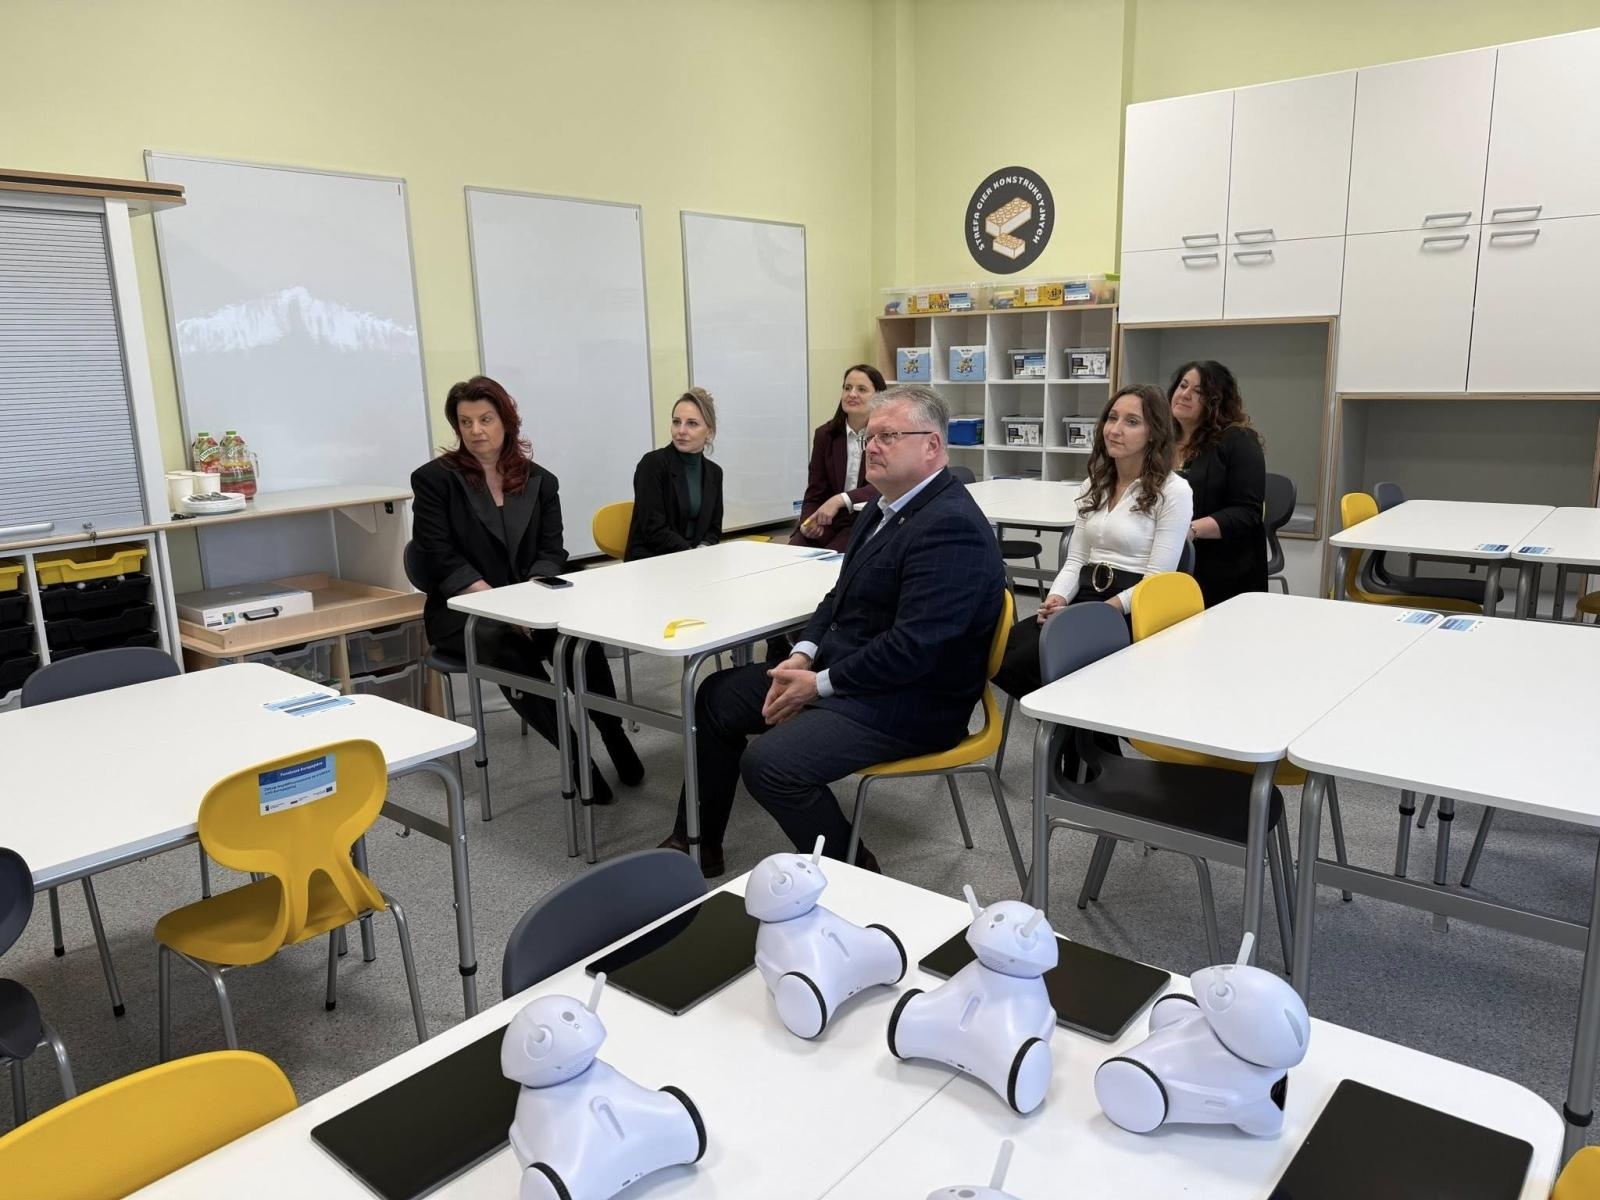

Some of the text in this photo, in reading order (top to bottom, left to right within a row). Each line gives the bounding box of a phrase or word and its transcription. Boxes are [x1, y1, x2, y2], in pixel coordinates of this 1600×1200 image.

[973, 176, 1046, 251] STREFA GIER KONSTRUKCYJNYCH
